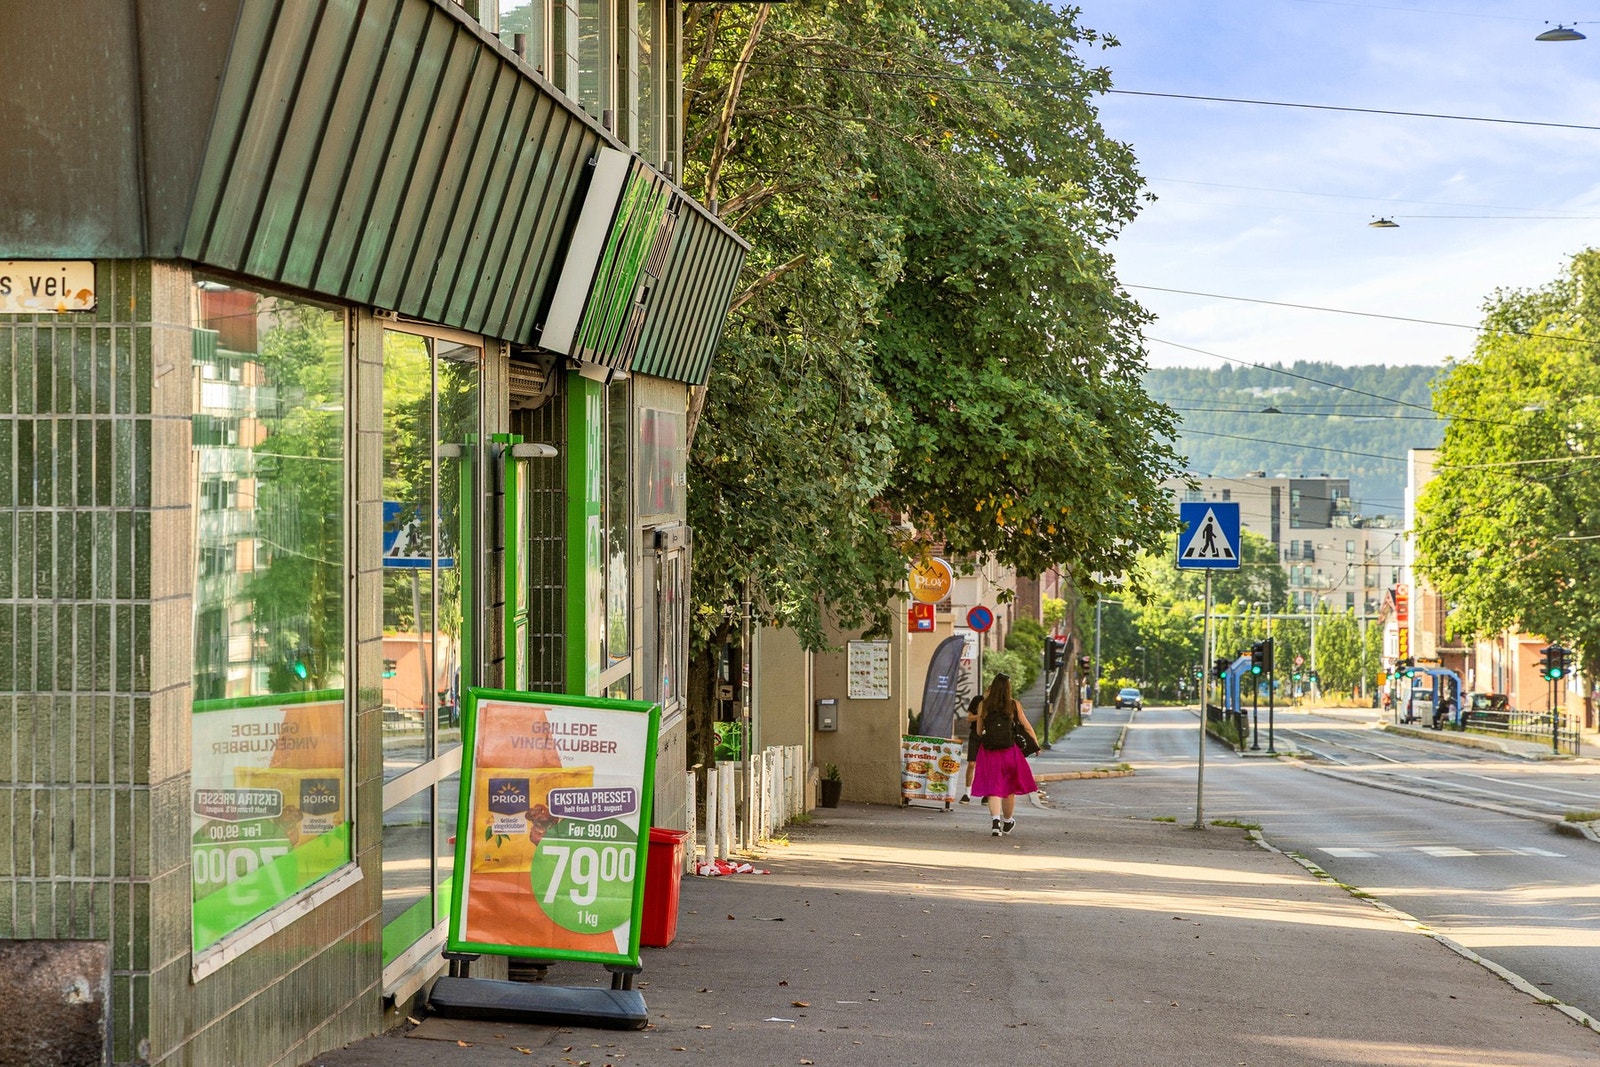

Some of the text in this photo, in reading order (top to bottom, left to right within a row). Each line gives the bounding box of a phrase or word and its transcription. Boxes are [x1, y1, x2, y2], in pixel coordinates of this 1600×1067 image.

[29, 267, 66, 297] vei
[531, 721, 598, 737] GRILLEDE
[511, 736, 617, 754] VINGEKLUBBER
[492, 795, 526, 804] PRIOR
[554, 791, 632, 806] EKSTRA PRESSET
[603, 805, 623, 813] august
[568, 823, 617, 840] Før 99,00
[577, 910, 598, 927] 1 kg
